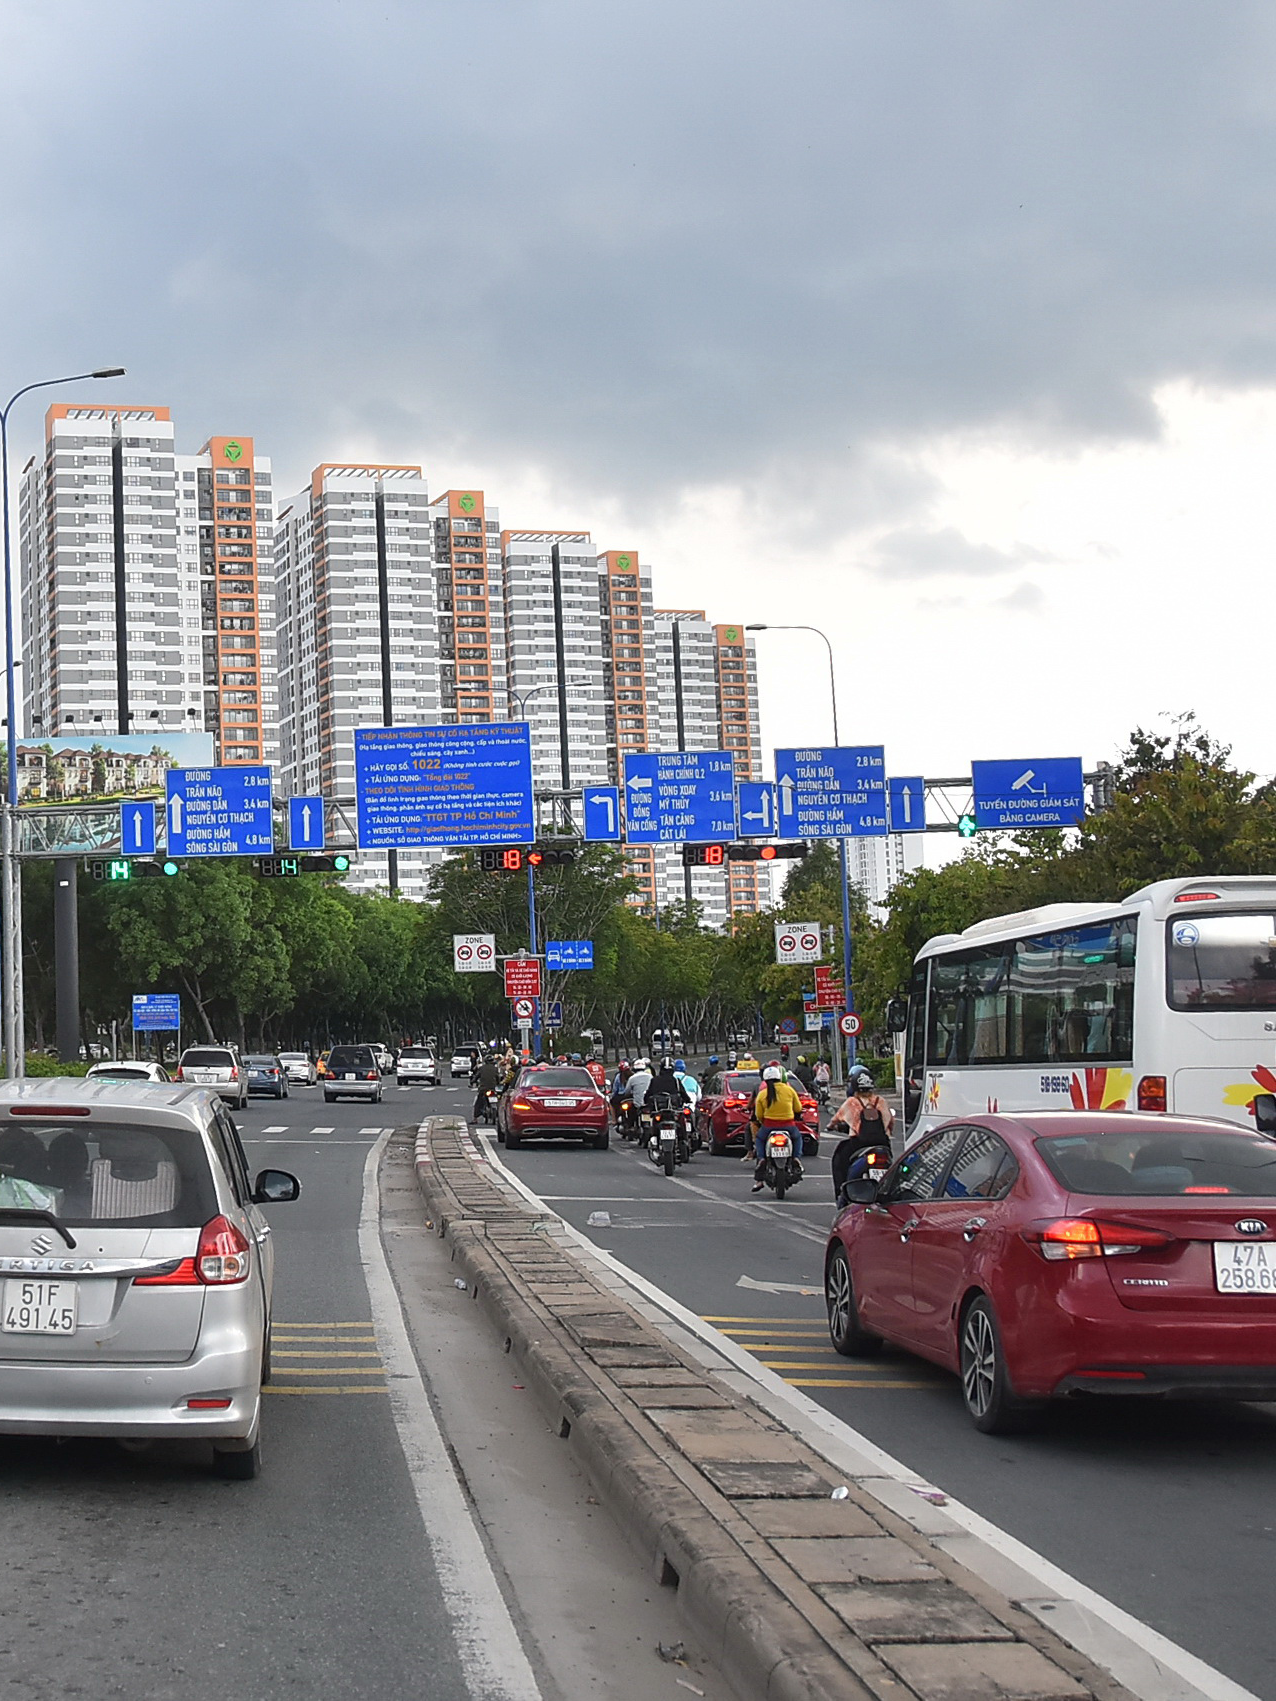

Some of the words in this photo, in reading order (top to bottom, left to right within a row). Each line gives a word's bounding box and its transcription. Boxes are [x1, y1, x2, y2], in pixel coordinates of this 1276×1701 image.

[658, 756, 681, 766] TRUNG
[683, 754, 698, 765] TÂM
[795, 750, 821, 762] ĐƯỜNG
[870, 756, 881, 766] km
[413, 759, 440, 769] 1022
[720, 761, 731, 771] km
[185, 769, 211, 781] ĐƯỜNG
[676, 767, 693, 779] CHÍNH
[796, 765, 816, 778] TRẦN
[819, 766, 834, 777] NÃO
[257, 776, 269, 785] km
[871, 779, 883, 789] km
[186, 784, 206, 797] TRẦN
[207, 785, 222, 797] NÃO
[659, 783, 678, 796] VÒNG
[631, 791, 652, 804] ĐƯỜNG
[721, 791, 732, 801] km
[798, 792, 828, 805] NGUYỄN
[830, 794, 840, 804] CƠ
[842, 794, 867, 805] THẠCH
[186, 799, 211, 811] ĐƯỜNG
[257, 799, 269, 808] km
[979, 798, 1006, 809] TUYẾN
[1009, 798, 1038, 808] ĐƯỜNG
[1040, 797, 1061, 807] GIÁM
[1063, 796, 1079, 807] SÁT
[187, 811, 216, 825] NGUYỄN
[218, 813, 228, 823] CƠ
[230, 812, 254, 824] THẠCH
[660, 814, 674, 826] TÂN
[798, 809, 824, 821] ĐƯỜNG
[827, 807, 843, 820] HẦM
[1000, 811, 1023, 823] BẰNG
[1025, 813, 1060, 822] CAMERA
[723, 821, 733, 830] km
[873, 816, 885, 826] km
[187, 827, 212, 840] ĐƯỜNG
[214, 826, 230, 838] HẦM
[660, 827, 673, 839] CÁT
[675, 827, 686, 839] LÁI
[798, 823, 819, 835] SÔNG
[822, 822, 833, 834] SÀI
[836, 822, 852, 834] GÒN
[259, 835, 270, 844] km
[186, 841, 207, 853] SÔNG
[208, 841, 220, 852] SÀI
[222, 841, 238, 852] GÒN
[503, 849, 521, 871] 18
[705, 846, 722, 864] 18
[111, 861, 128, 880] 14
[281, 859, 297, 875] 14
[845, 1019, 856, 1029] 50
[1241, 1222, 1262, 1232] KIA
[1233, 1246, 1267, 1266] 47A
[22, 1284, 59, 1306] 51F
[6, 1307, 73, 1330] 491.45
